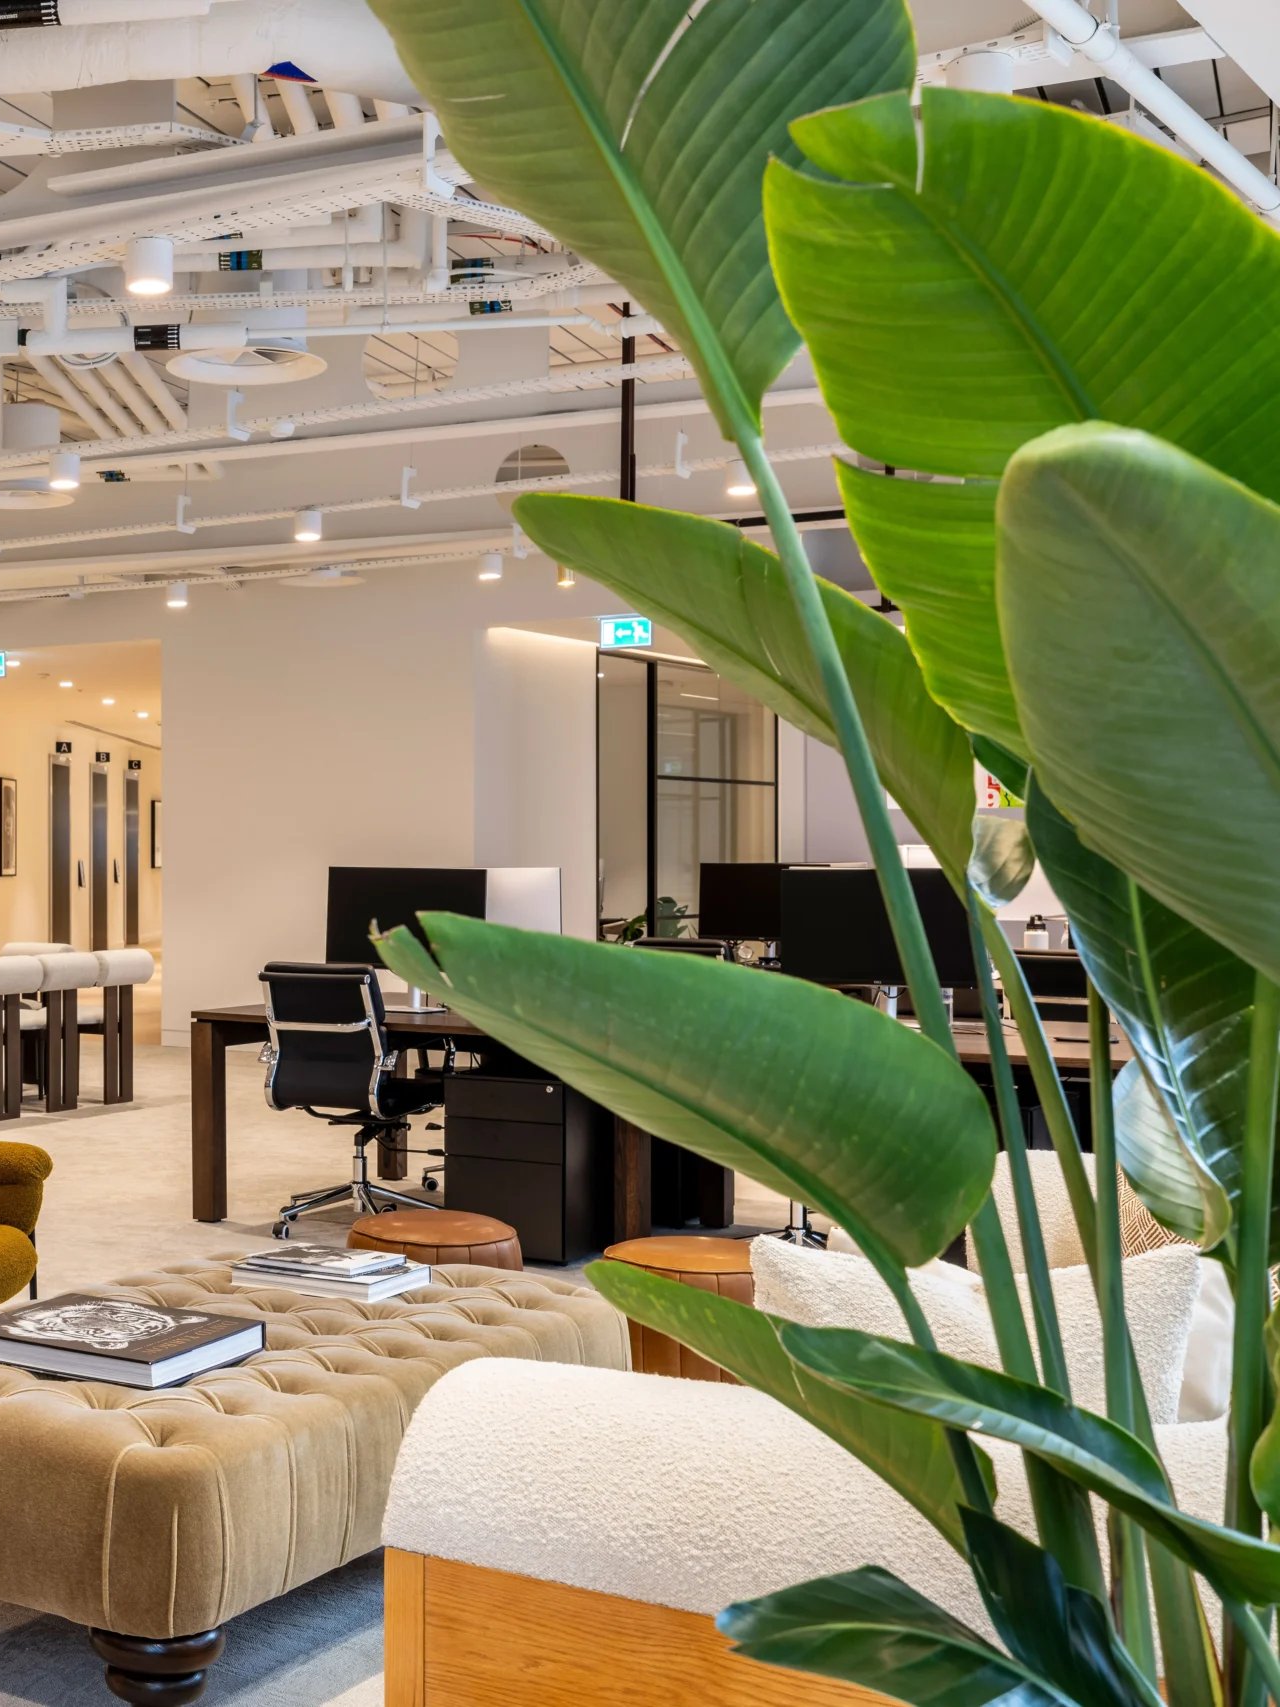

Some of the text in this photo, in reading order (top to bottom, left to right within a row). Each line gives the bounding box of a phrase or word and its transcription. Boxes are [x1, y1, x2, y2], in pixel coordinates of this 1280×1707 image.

[60, 743, 68, 752] A
[100, 753, 107, 762] B
[132, 761, 138, 769] C
